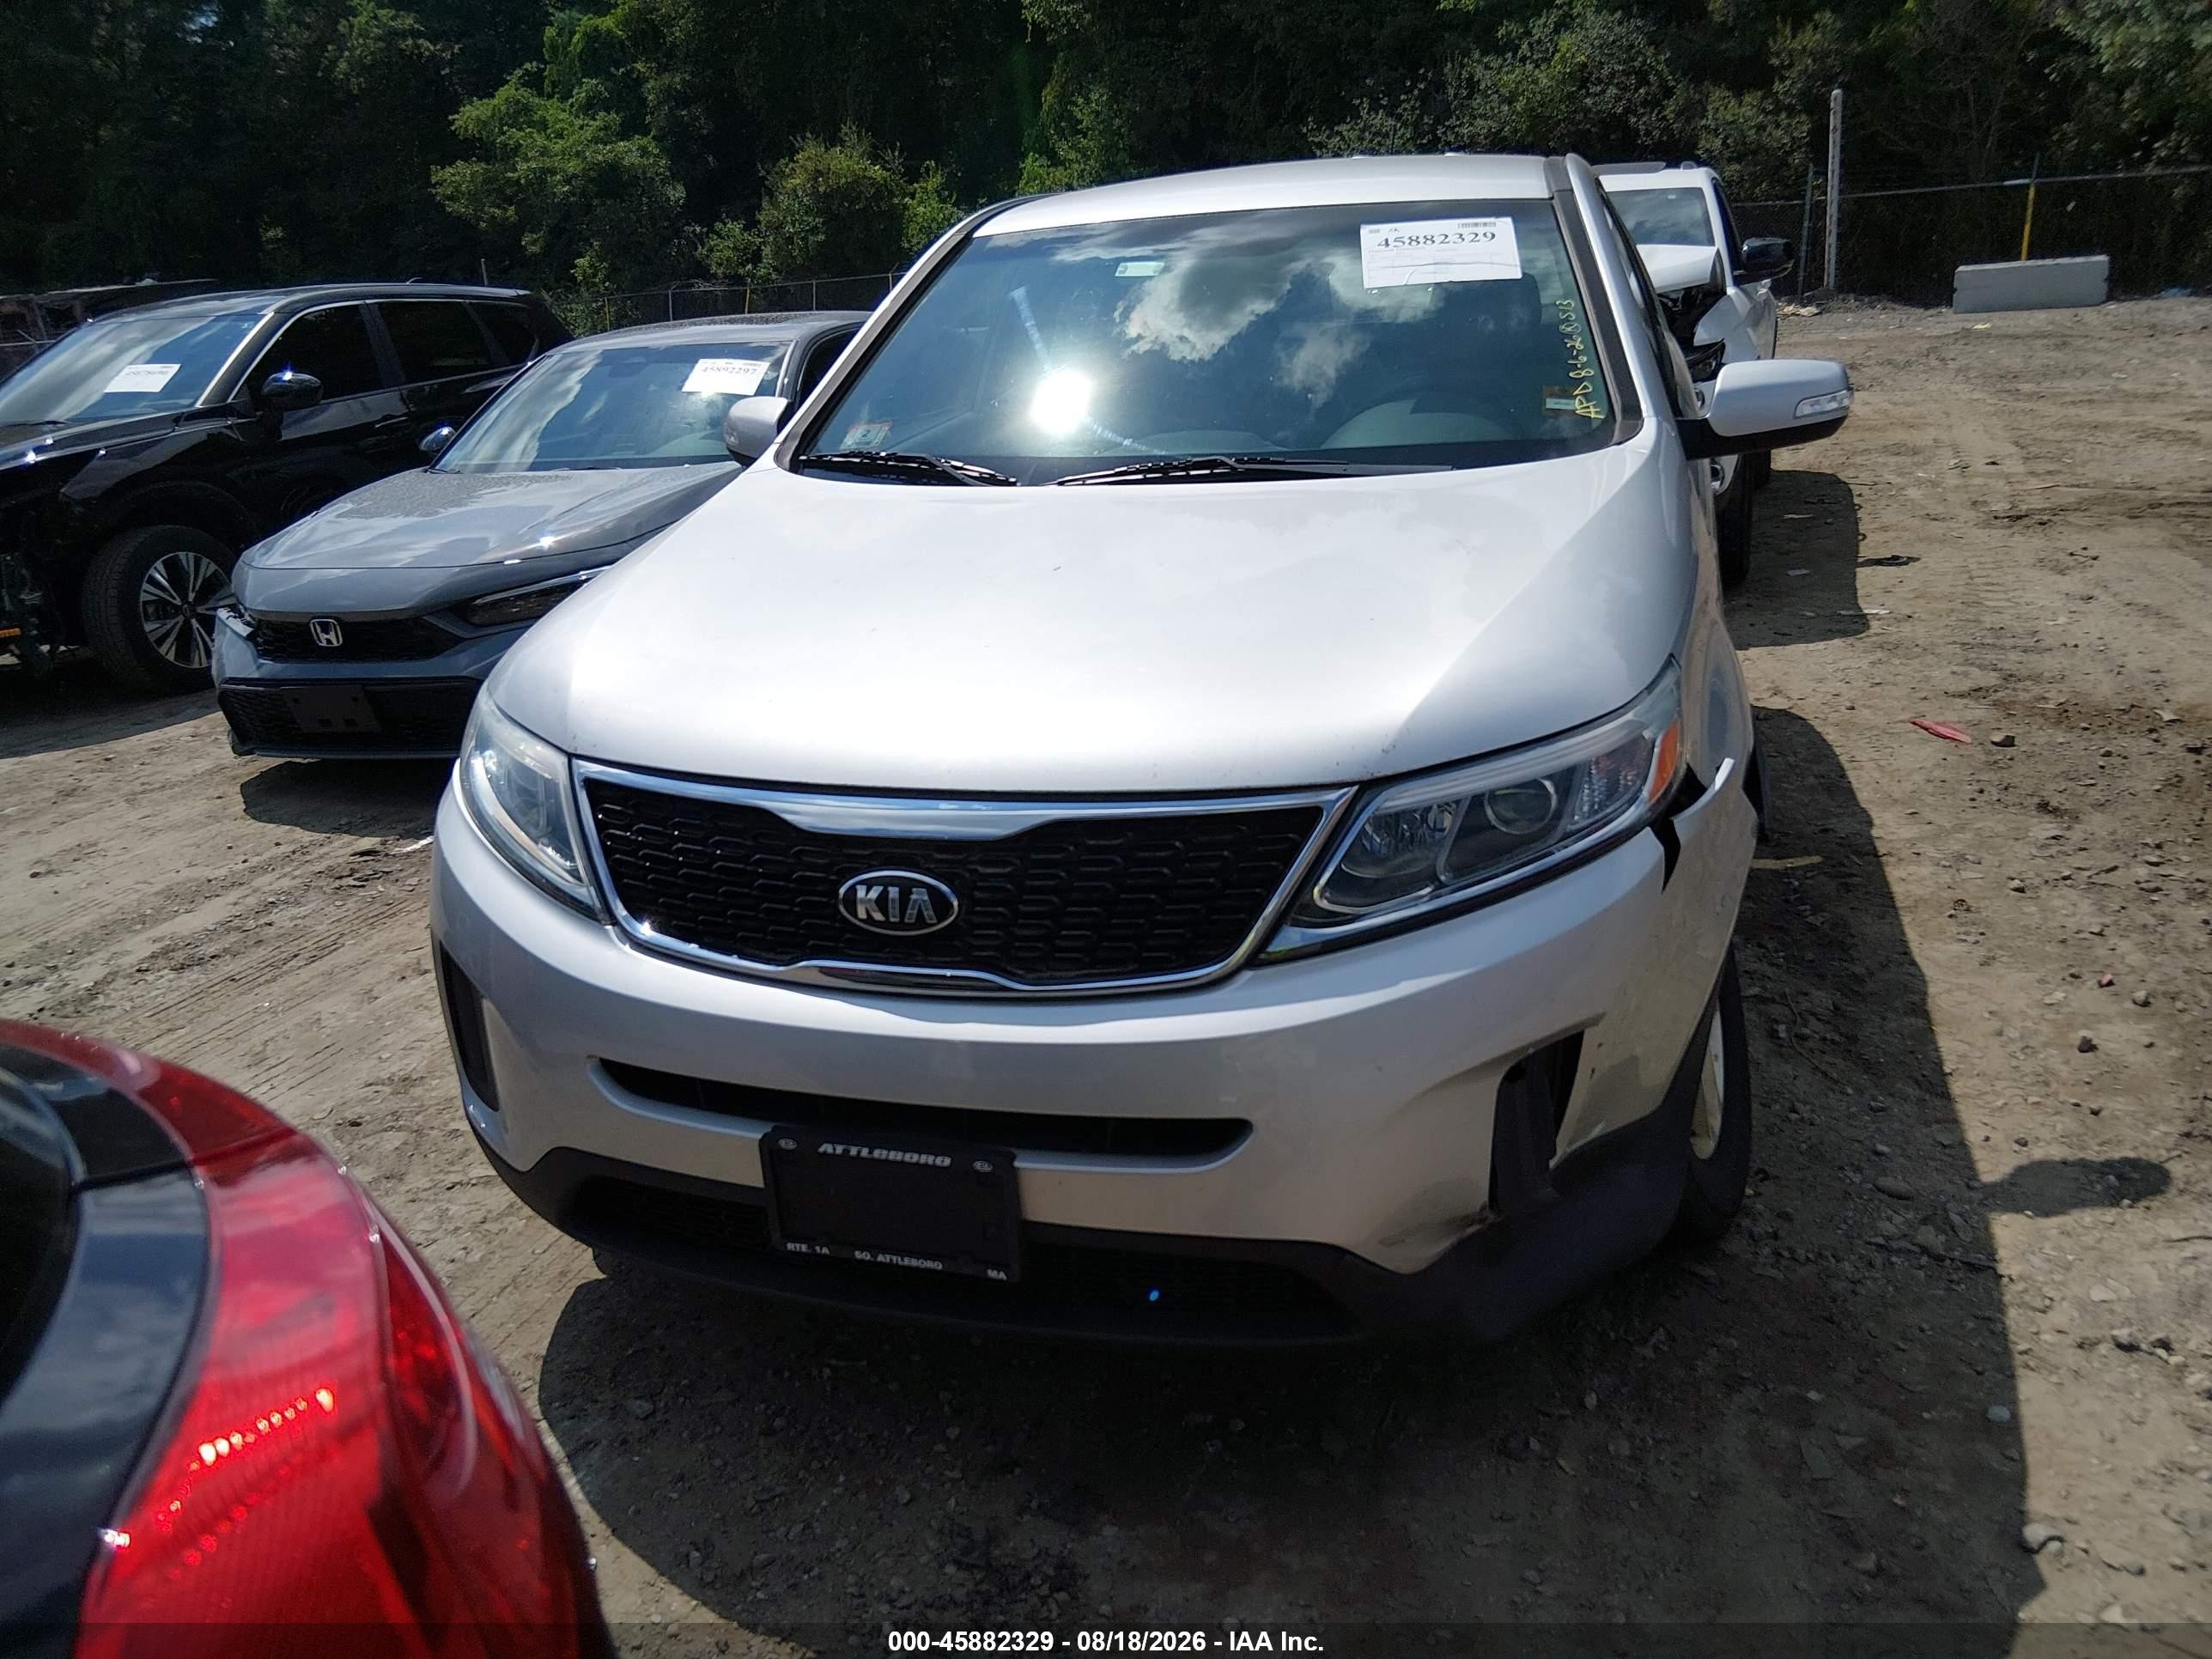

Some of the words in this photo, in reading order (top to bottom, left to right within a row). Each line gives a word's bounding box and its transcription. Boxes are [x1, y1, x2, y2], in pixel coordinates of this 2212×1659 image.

[1376, 231, 1497, 248] 45882329
[855, 884, 938, 924] KIA
[817, 1143, 951, 1167] ATTLEBORO
[814, 1245, 830, 1255] 1A
[877, 1254, 943, 1270] ATTLEBORO
[987, 1269, 1007, 1279] MA
